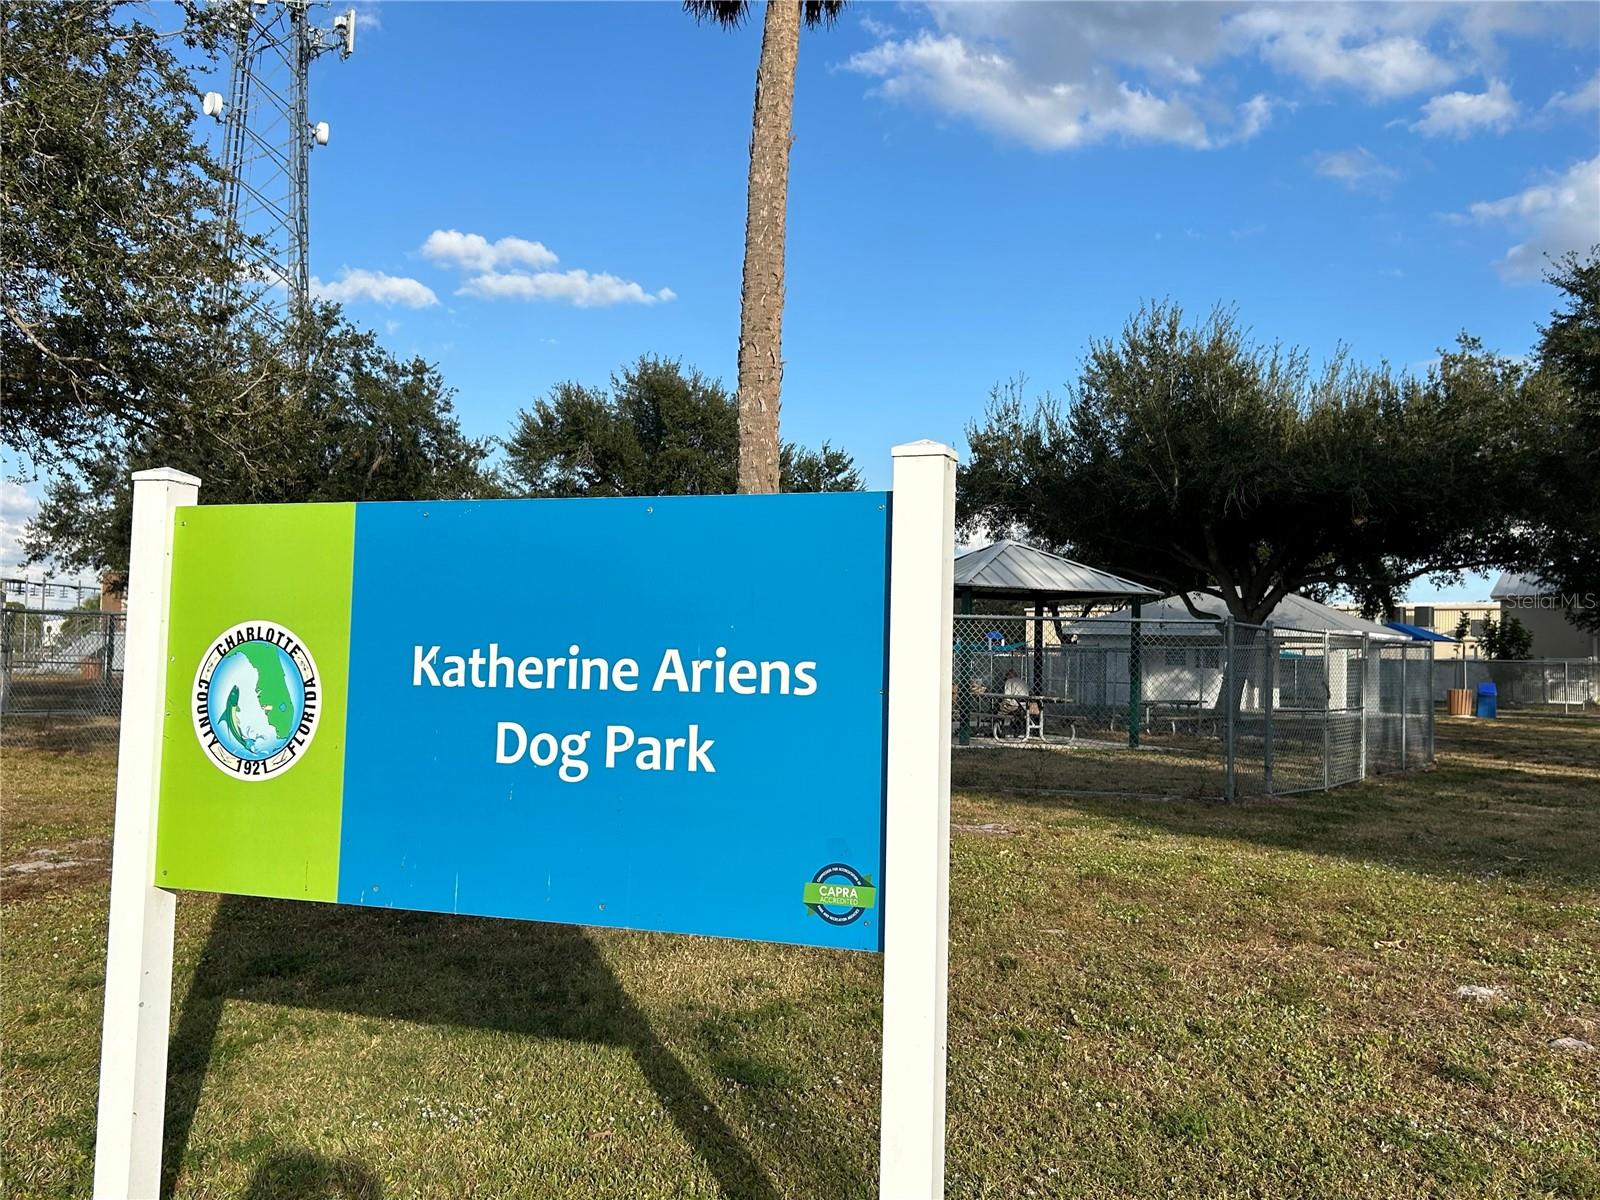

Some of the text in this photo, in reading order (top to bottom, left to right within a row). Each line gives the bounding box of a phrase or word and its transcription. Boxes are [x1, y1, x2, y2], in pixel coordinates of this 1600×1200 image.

[215, 626, 302, 659] CHARLOTTE
[412, 642, 818, 696] Katherine Ariens
[196, 679, 219, 748] COUNTY
[288, 676, 317, 757] FLORIDA
[236, 759, 268, 775] 1921
[495, 721, 717, 783] Dog Park
[819, 886, 858, 898] CAPRA
[820, 896, 858, 905] ACCREDITED
